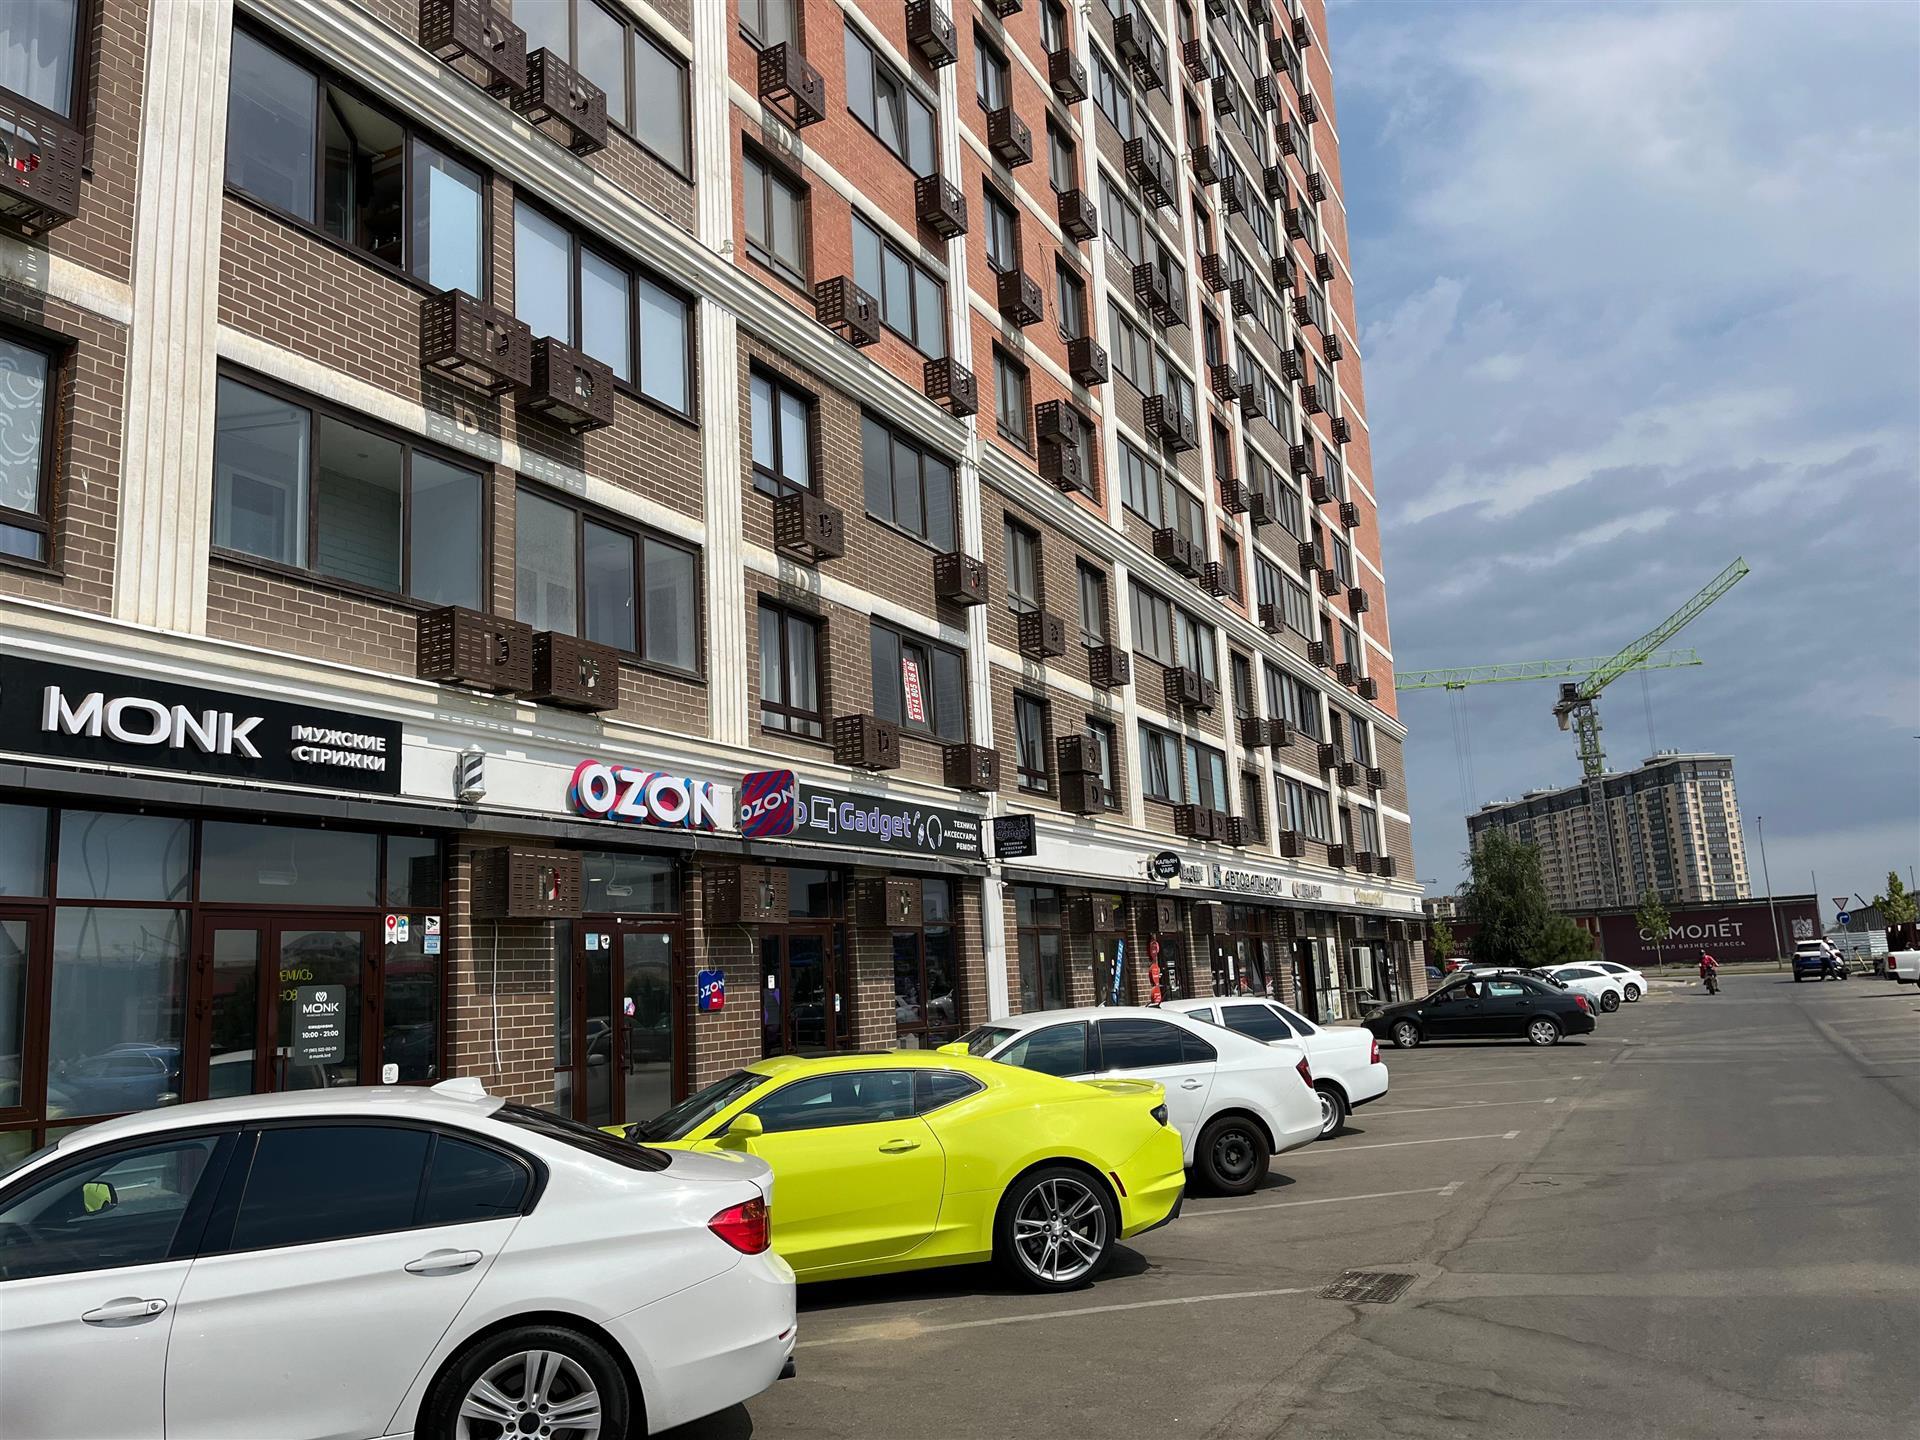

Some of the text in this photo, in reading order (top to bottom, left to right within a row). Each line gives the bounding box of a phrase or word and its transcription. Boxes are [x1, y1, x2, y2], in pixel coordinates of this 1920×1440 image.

[42, 685, 265, 759] MONK
[291, 725, 386, 751] МУЖСКИЕ
[291, 746, 386, 773] СТРИЖКИ
[574, 761, 720, 829] OZON
[741, 785, 797, 822] OZON
[839, 801, 912, 842] Gadget
[952, 819, 978, 831] ТЕХНИКА
[943, 829, 978, 842] АКСЕССУАРЫ
[956, 841, 978, 852] РЕМОНТ
[1225, 870, 1282, 892] АВТОЗАПЧАСТИ
[302, 1002, 339, 1013] MONK
